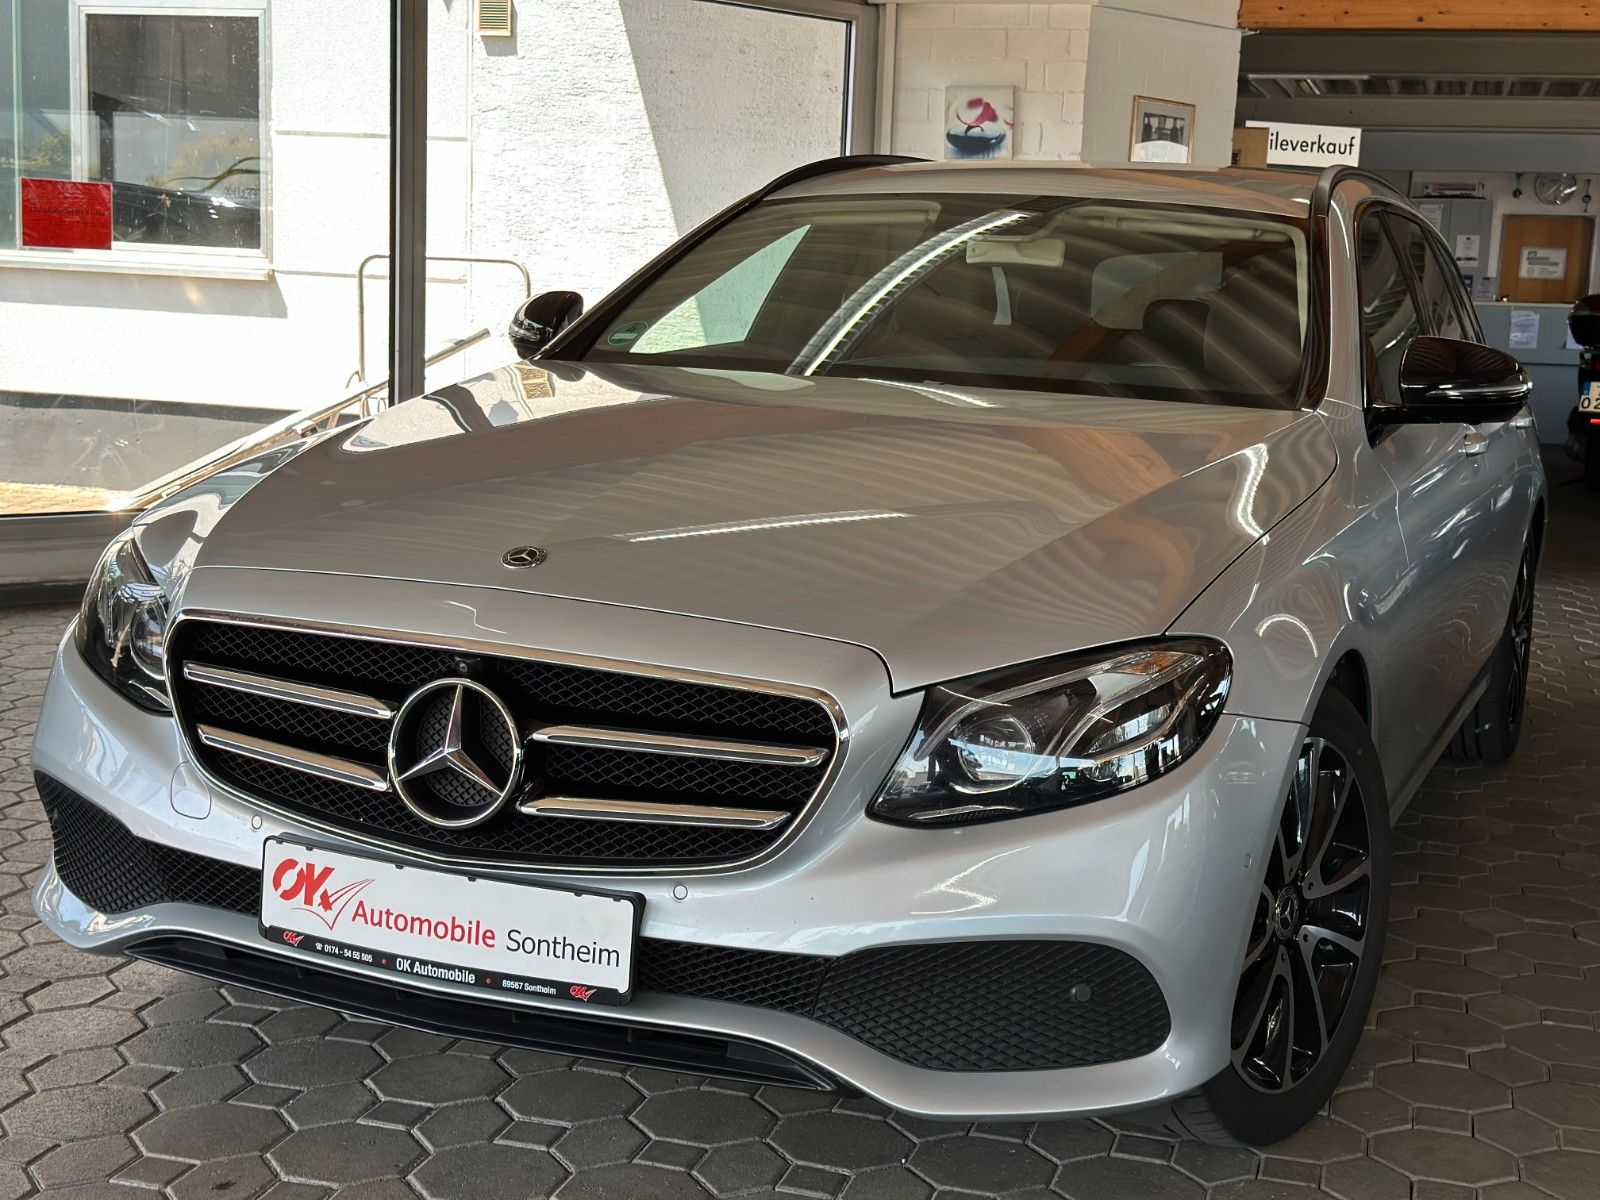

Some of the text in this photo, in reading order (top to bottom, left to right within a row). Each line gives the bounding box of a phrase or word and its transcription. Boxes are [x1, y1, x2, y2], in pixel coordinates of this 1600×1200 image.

[1269, 131, 1356, 155] ileverkauf
[272, 858, 335, 912] OK
[351, 900, 620, 968] Automobile Sontheim
[324, 944, 339, 955] 0174
[344, 948, 352, 958] 54
[352, 951, 360, 960] 55
[361, 953, 373, 963] 505
[396, 957, 476, 984] OK Automobile
[502, 979, 557, 995] 89567 Sontheim
